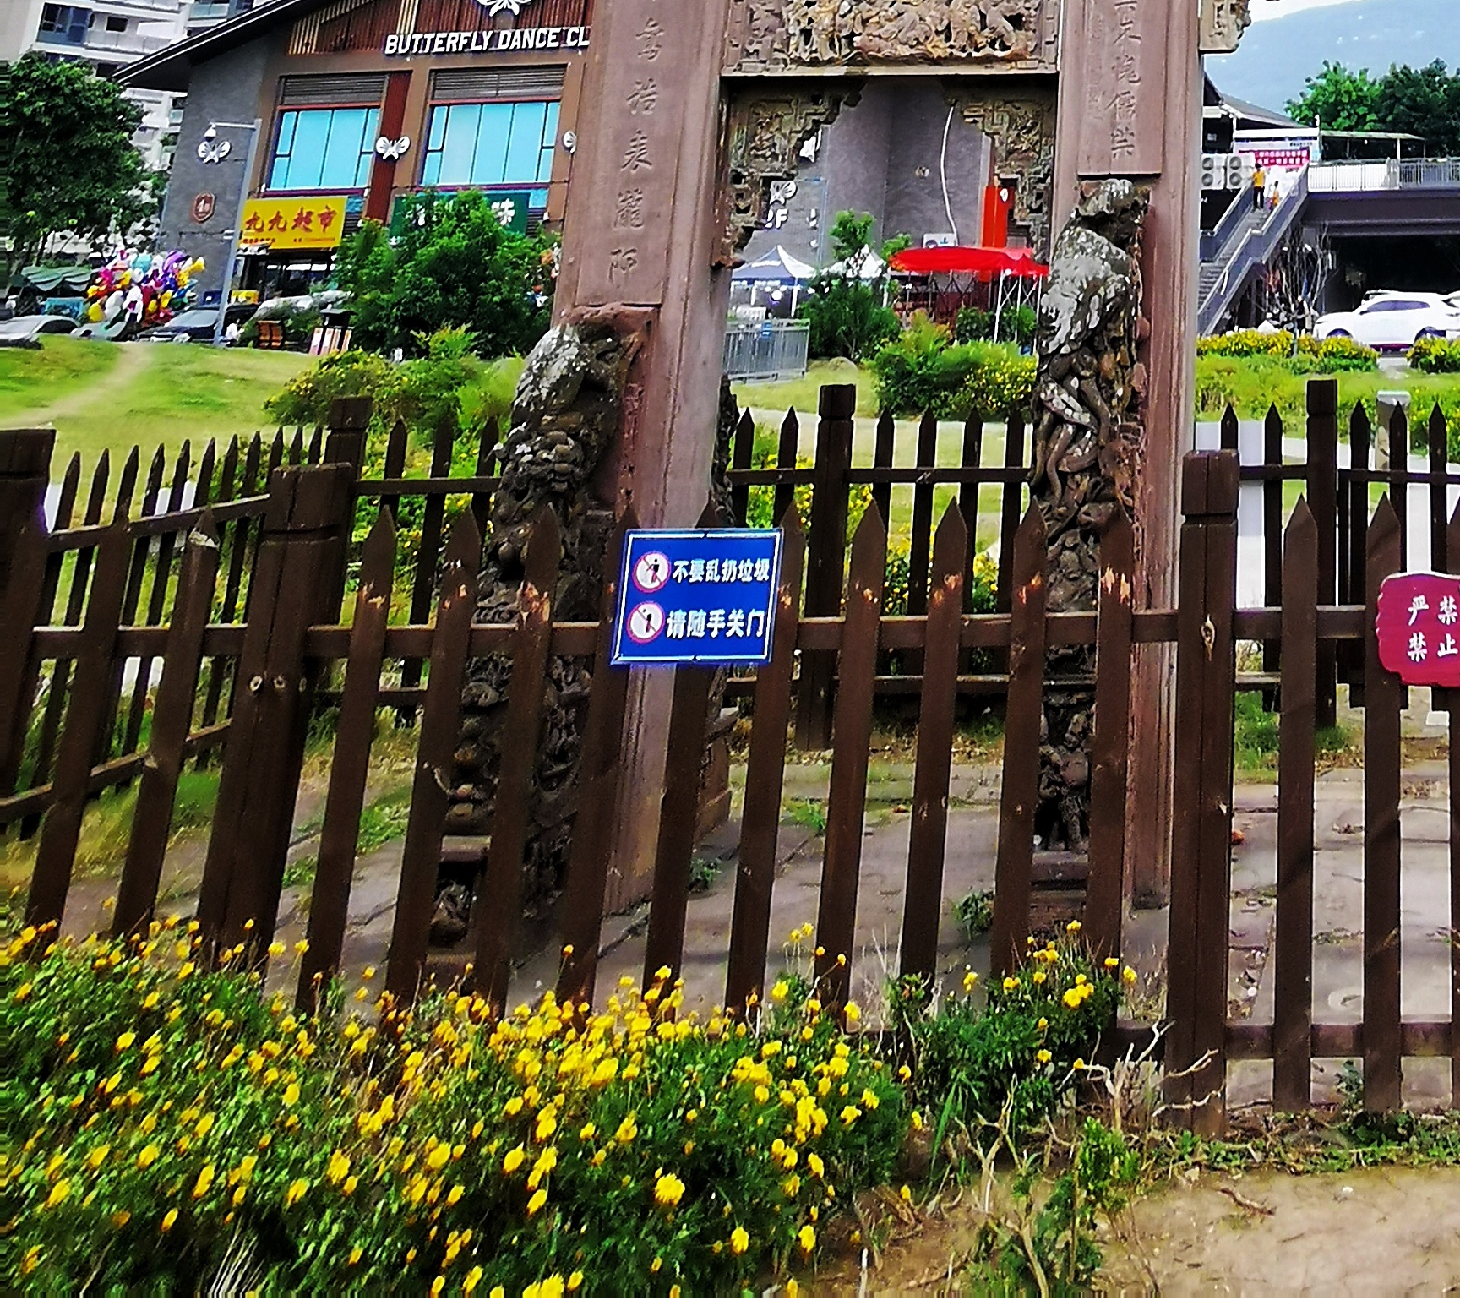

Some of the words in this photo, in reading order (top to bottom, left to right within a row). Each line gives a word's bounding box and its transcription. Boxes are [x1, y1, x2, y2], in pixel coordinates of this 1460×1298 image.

[384, 31, 493, 54] BUTTERFLY
[497, 27, 560, 50] DANCE
[245, 204, 338, 233] 九九超市
[672, 558, 771, 584] 不要乱扔垃圾
[666, 608, 766, 639] 请随手关门
